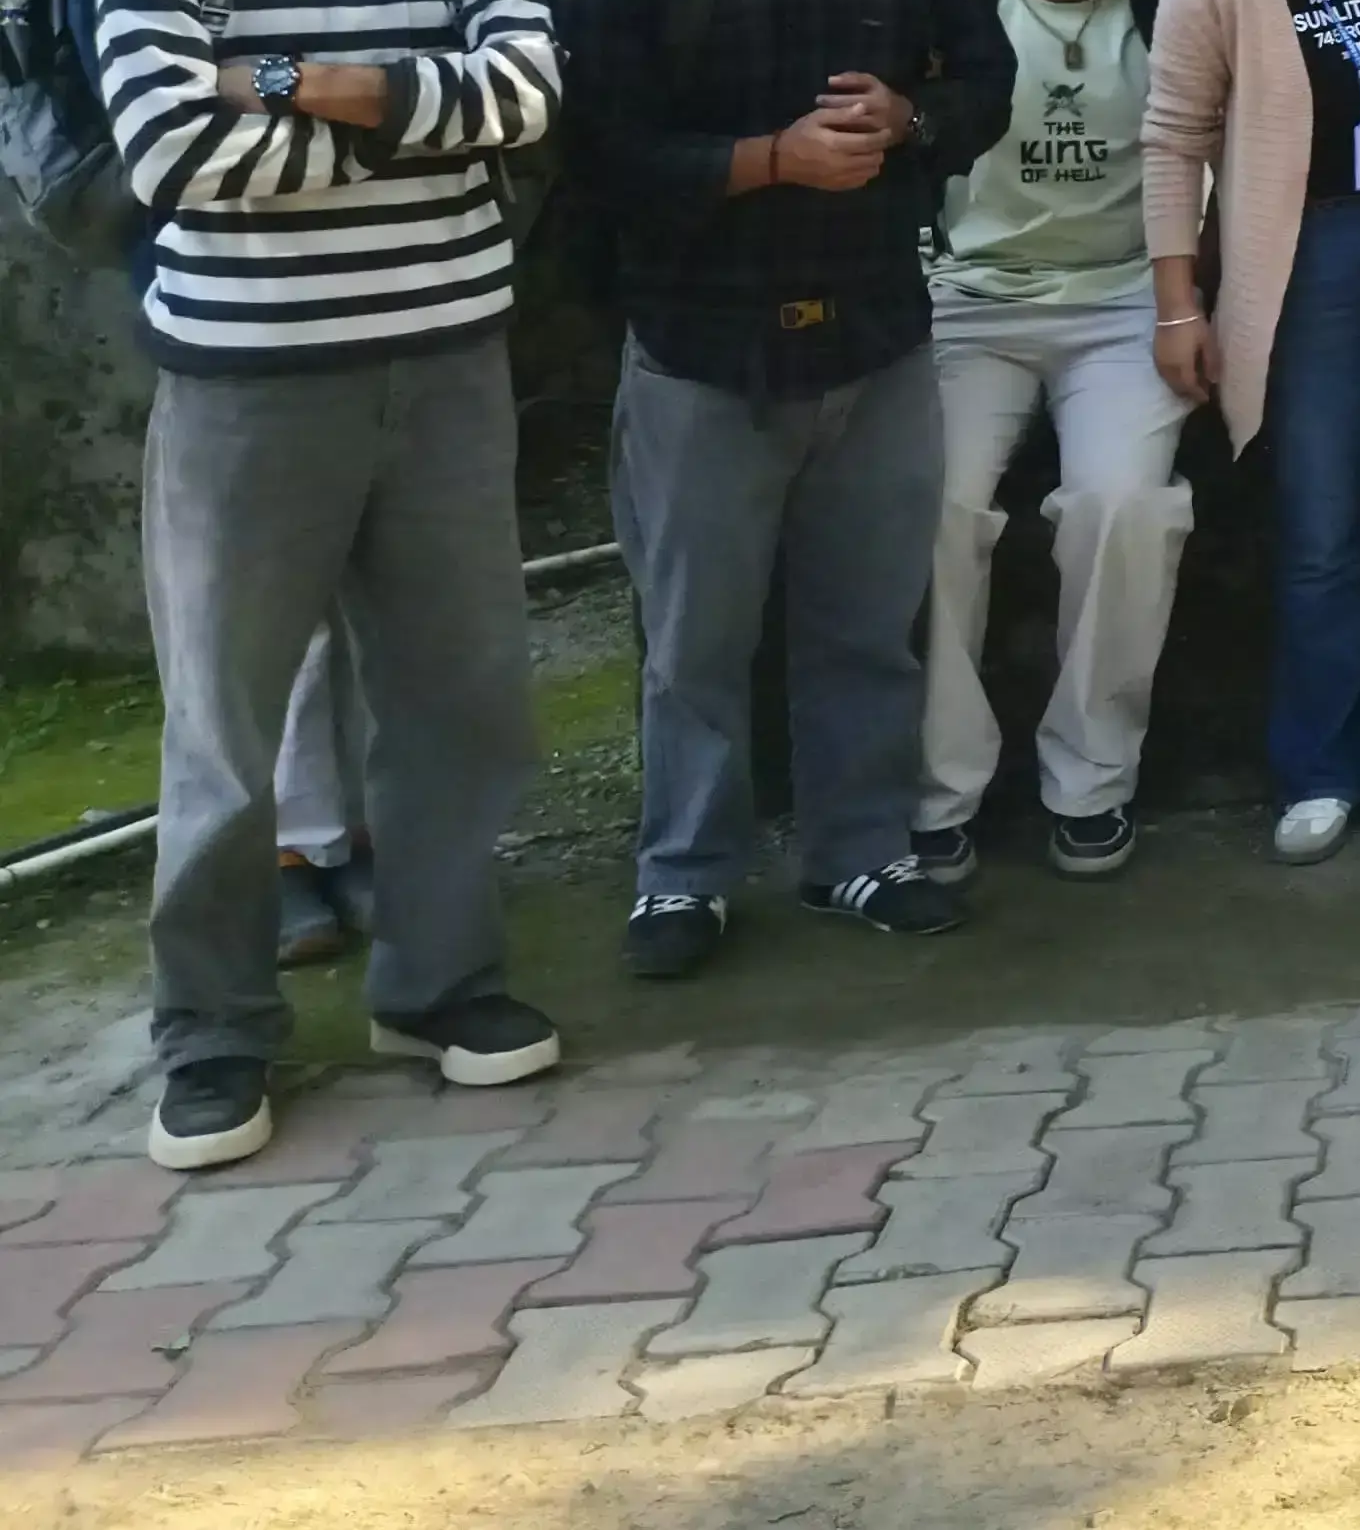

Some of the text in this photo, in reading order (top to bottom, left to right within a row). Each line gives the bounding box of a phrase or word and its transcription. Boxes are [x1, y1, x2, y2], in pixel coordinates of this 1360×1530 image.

[1043, 121, 1085, 135] THE
[1020, 140, 1108, 165] KING
[1021, 166, 1106, 183] OF HELL
